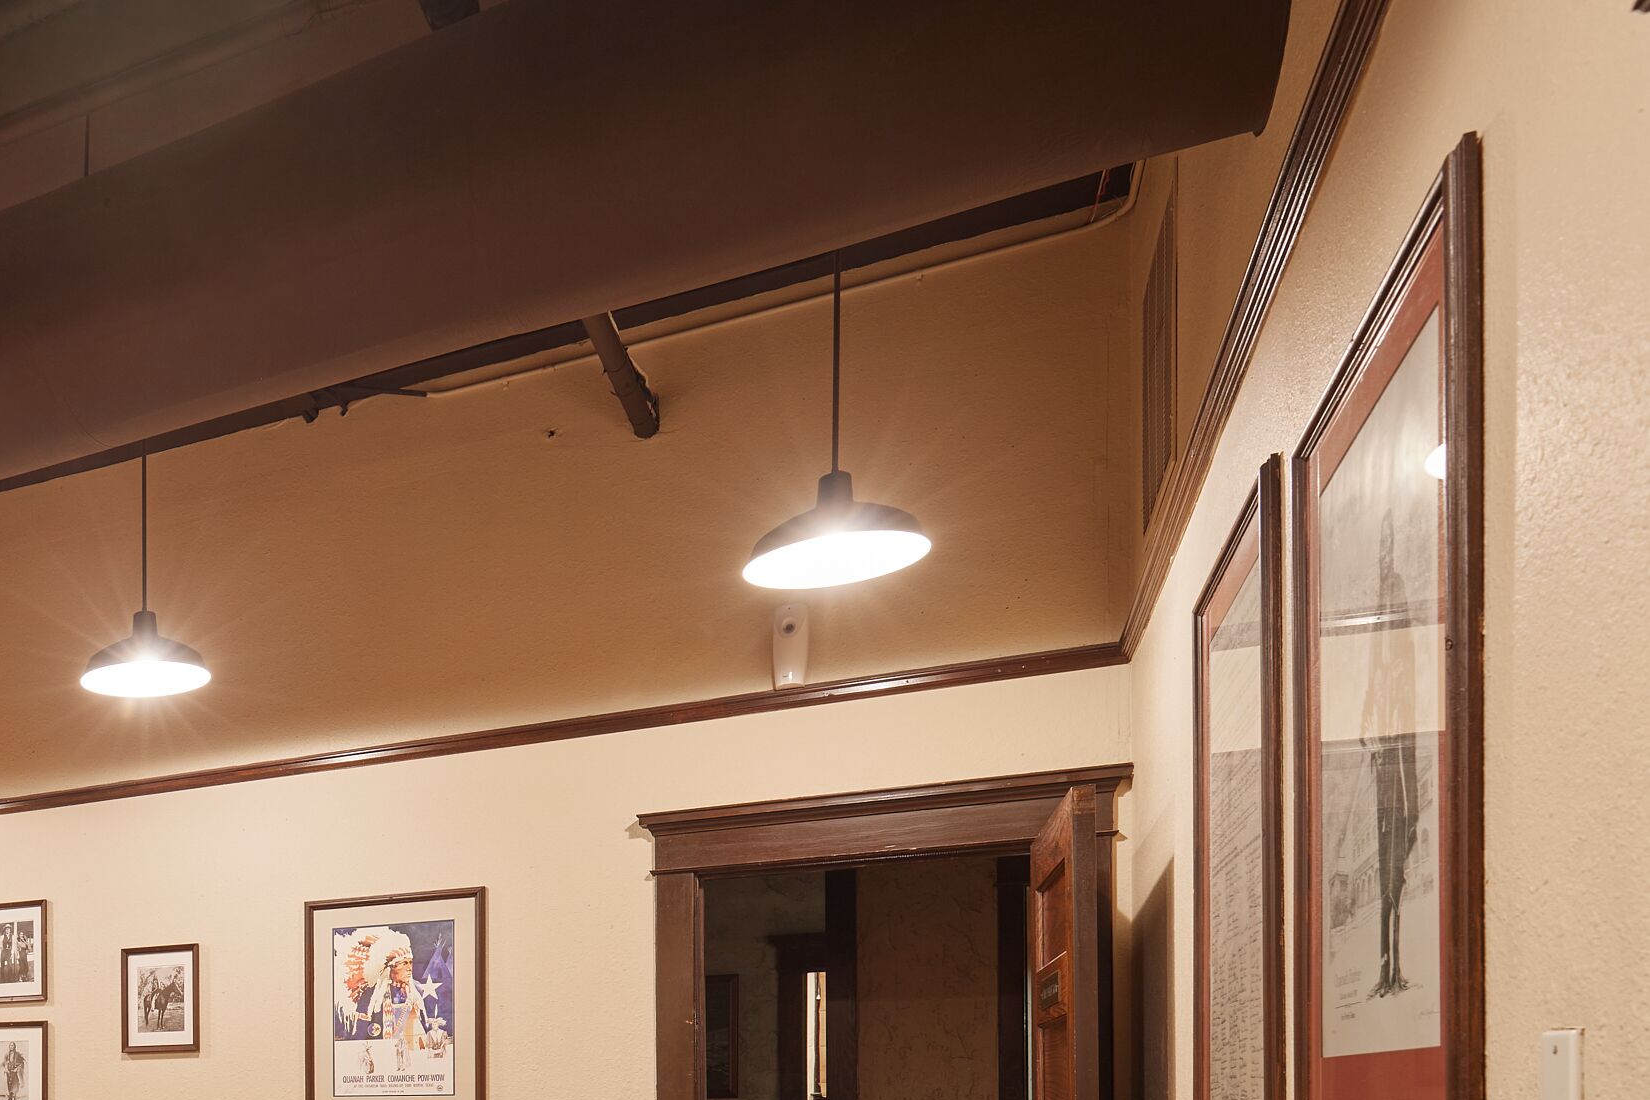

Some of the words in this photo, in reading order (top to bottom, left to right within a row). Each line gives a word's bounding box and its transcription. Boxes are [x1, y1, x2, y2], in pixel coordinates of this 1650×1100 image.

[342, 1075, 364, 1083] QUANAH
[366, 1075, 385, 1083] PARKER
[387, 1074, 415, 1082] COMANCHE
[417, 1074, 445, 1082] POW-WOW
